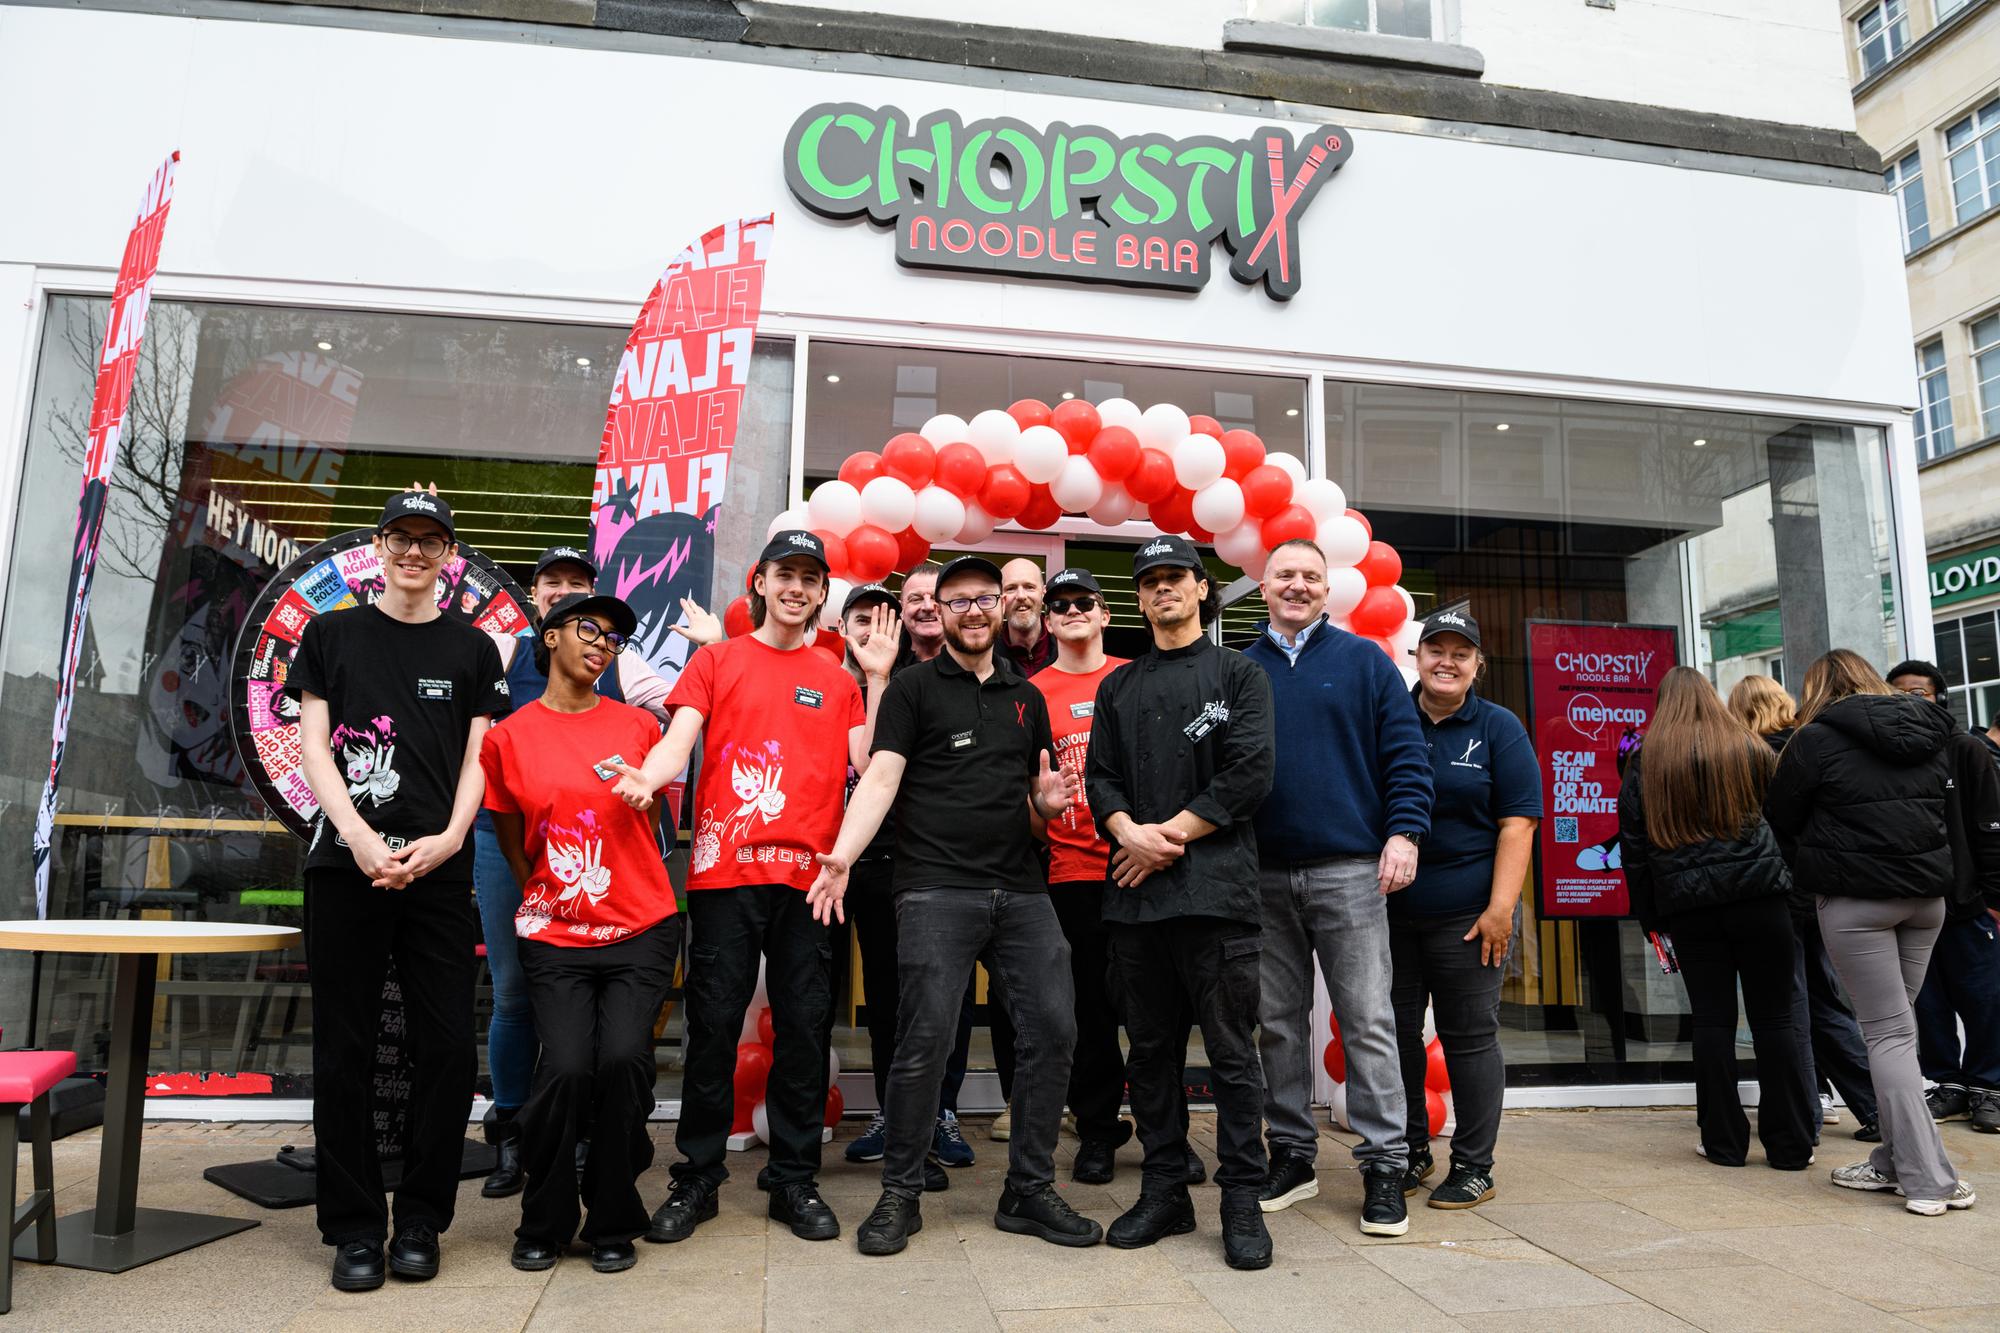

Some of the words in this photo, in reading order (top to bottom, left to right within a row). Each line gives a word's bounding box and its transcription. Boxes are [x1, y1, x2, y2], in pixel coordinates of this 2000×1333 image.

[798, 114, 1329, 283] CHOPSTIX
[910, 216, 1097, 264] NOODLE
[1116, 234, 1199, 274] BAR
[206, 489, 250, 546] HEY
[343, 557, 378, 576] AGAIN
[344, 547, 366, 563] TRY
[306, 572, 338, 598] SPRING
[1930, 556, 2000, 599] LOYD
[313, 581, 341, 604] ROLLS
[1555, 652, 1652, 684] CHOPSTIX
[1576, 673, 1610, 682] NOODLE
[251, 685, 260, 729] UNLUCKY
[1572, 707, 1646, 727] mencap
[1552, 750, 1595, 767] SCAN
[1553, 766, 1584, 782] THE
[284, 788, 306, 811] TRY
[1553, 781, 1577, 799] QR
[1580, 782, 1602, 798] TO
[1554, 797, 1617, 813] DONATE
